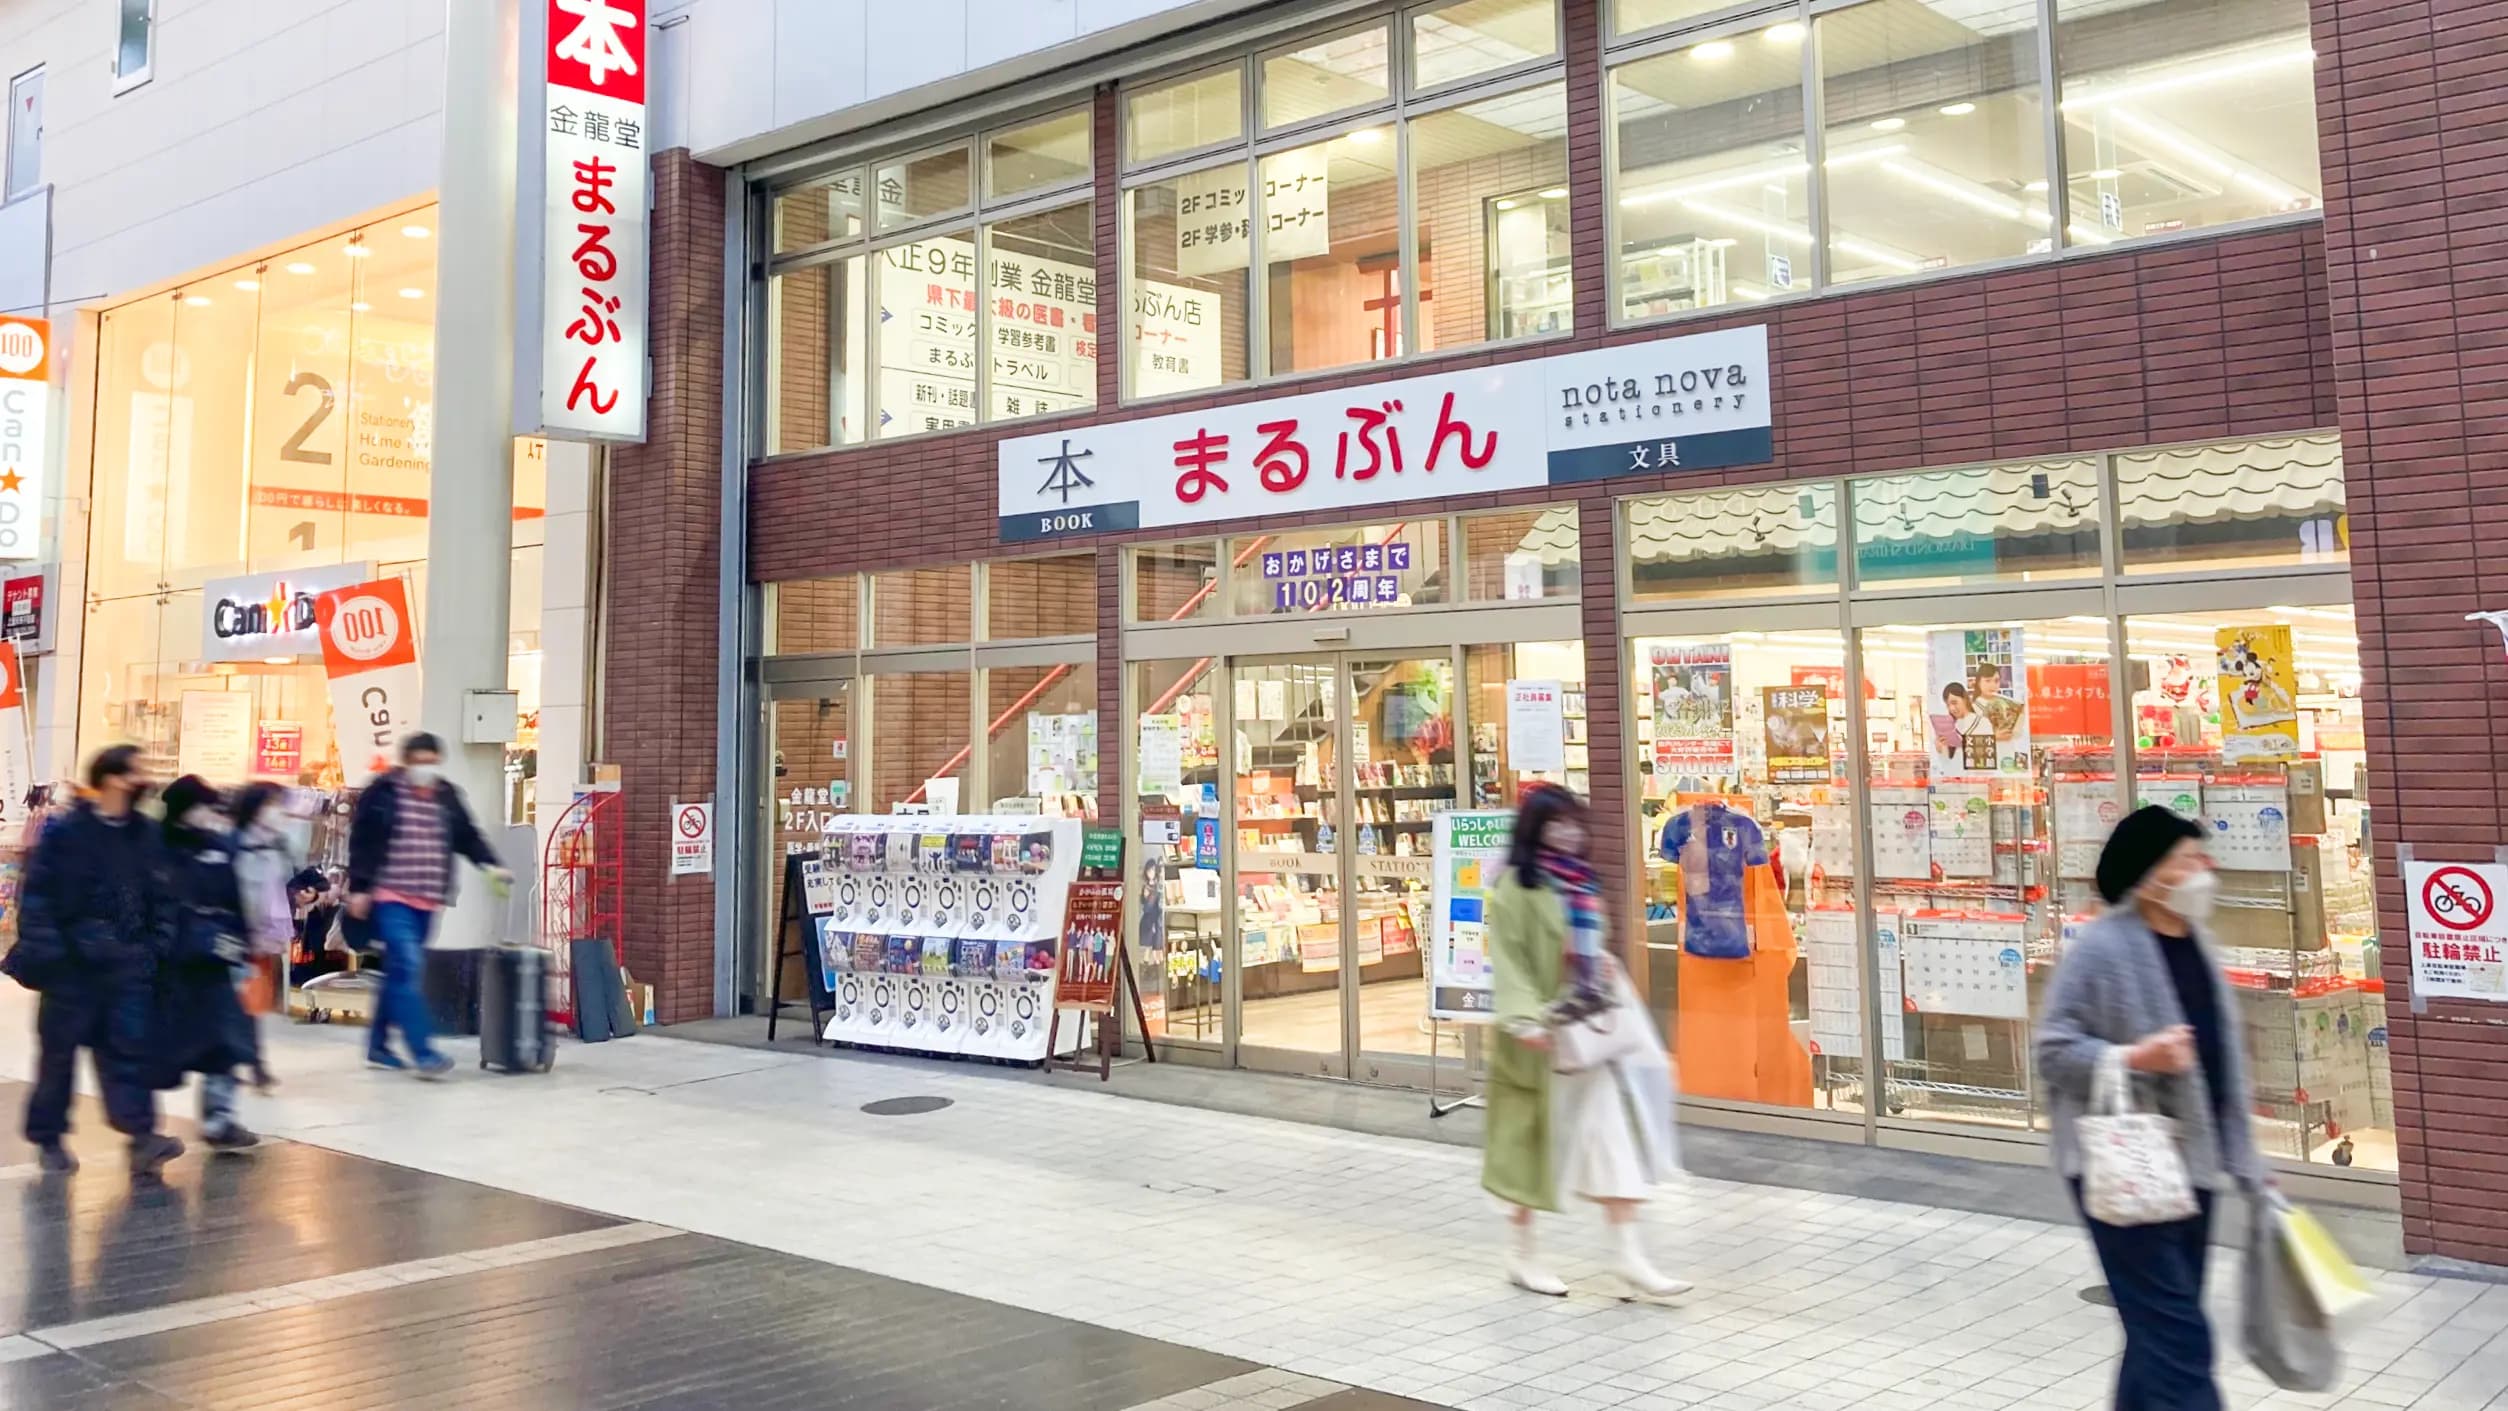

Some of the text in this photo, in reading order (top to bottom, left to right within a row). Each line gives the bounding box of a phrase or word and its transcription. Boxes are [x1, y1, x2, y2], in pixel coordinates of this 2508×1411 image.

[555, 0, 637, 86] 本
[550, 104, 641, 150] 金龍堂
[1181, 174, 1325, 214] 2F コミッコーナー
[1181, 231, 1200, 249] 2F
[565, 156, 622, 415] まるぶん
[1031, 267, 1097, 306] 金龍堂
[998, 327, 1056, 353] 学習参考書
[929, 347, 1049, 381] まるぶトラベル
[1152, 353, 1189, 375] 教育書
[916, 383, 977, 408] 新刊・話題
[1561, 362, 1747, 408] nota nova
[281, 371, 335, 466] 2
[360, 411, 416, 431] Stationery
[1563, 392, 1747, 428] stationery
[1172, 391, 1500, 505] まるぶん
[1627, 441, 1681, 471] 文具
[1036, 438, 1095, 504] 本
[1040, 512, 1095, 534] BOOK
[1265, 545, 1408, 575] おかげさまで
[1281, 577, 1396, 607] 102周年
[213, 597, 268, 638] Can
[784, 810, 833, 832] 2F入口
[1451, 818, 1508, 832] いらっしゃい
[2422, 942, 2503, 963] 駐輪禁止
